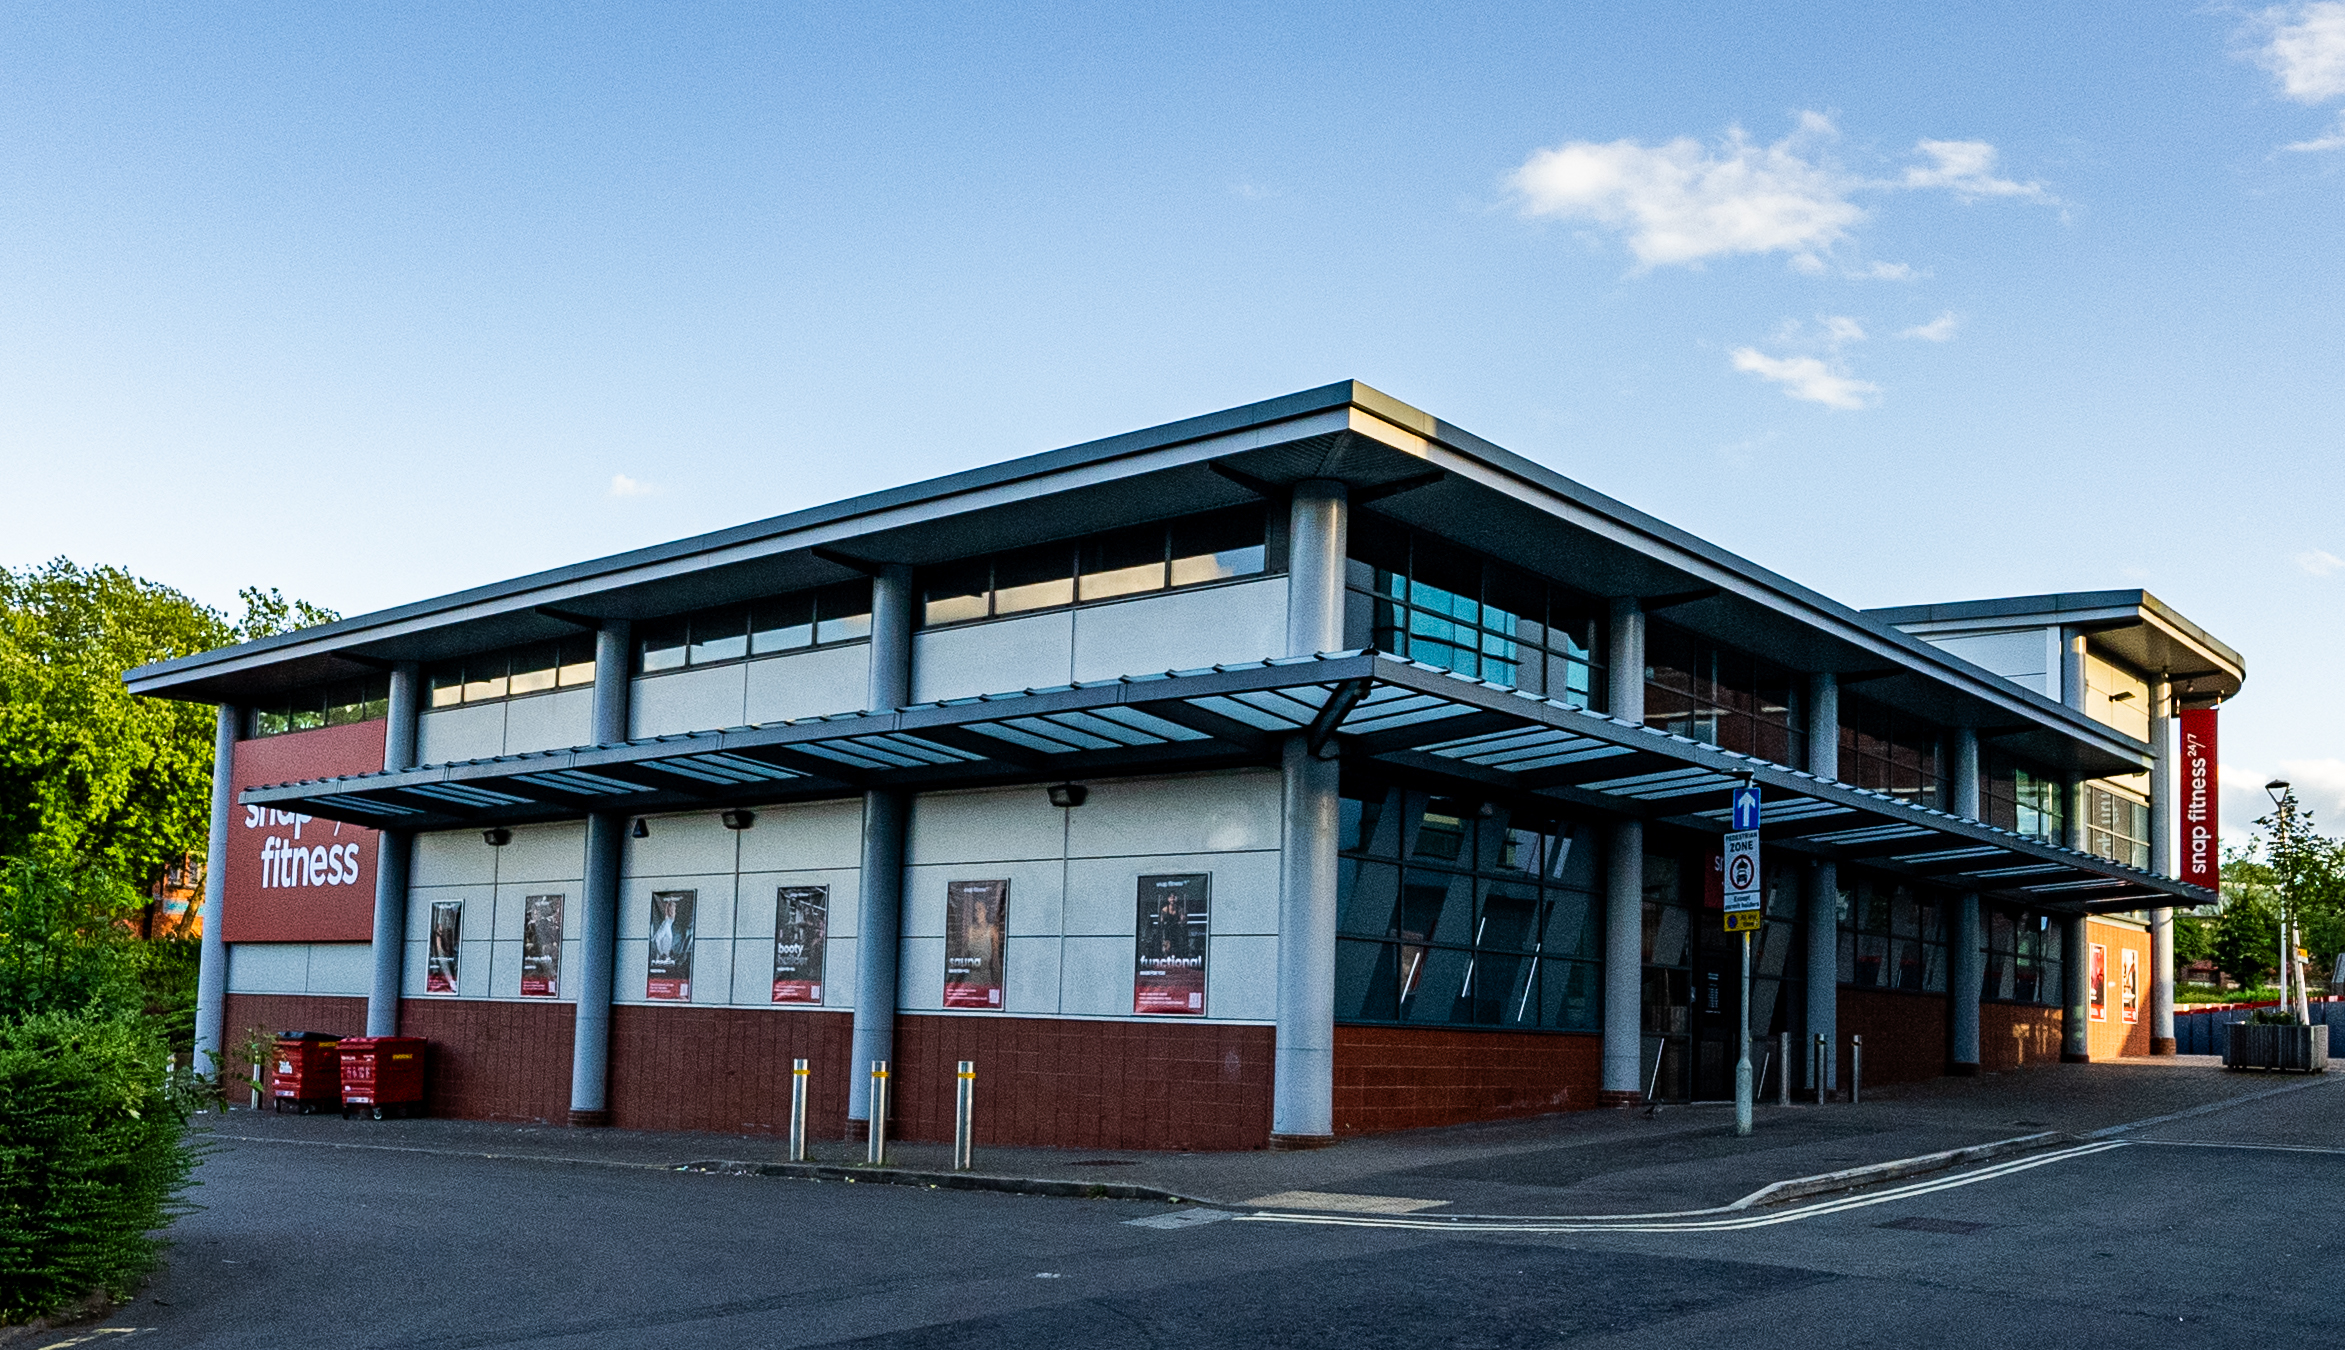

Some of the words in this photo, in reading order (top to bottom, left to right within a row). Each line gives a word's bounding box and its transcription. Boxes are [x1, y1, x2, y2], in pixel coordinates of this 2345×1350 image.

[2187, 732, 2207, 757] 24/7
[2187, 757, 2207, 823] fitness
[1725, 831, 1758, 844] PEDESTRIAN
[1730, 841, 1754, 853] ZONE
[2192, 826, 2212, 874] snap
[260, 835, 360, 889] fitness
[777, 942, 804, 958] booty
[1139, 954, 1202, 968] functional
